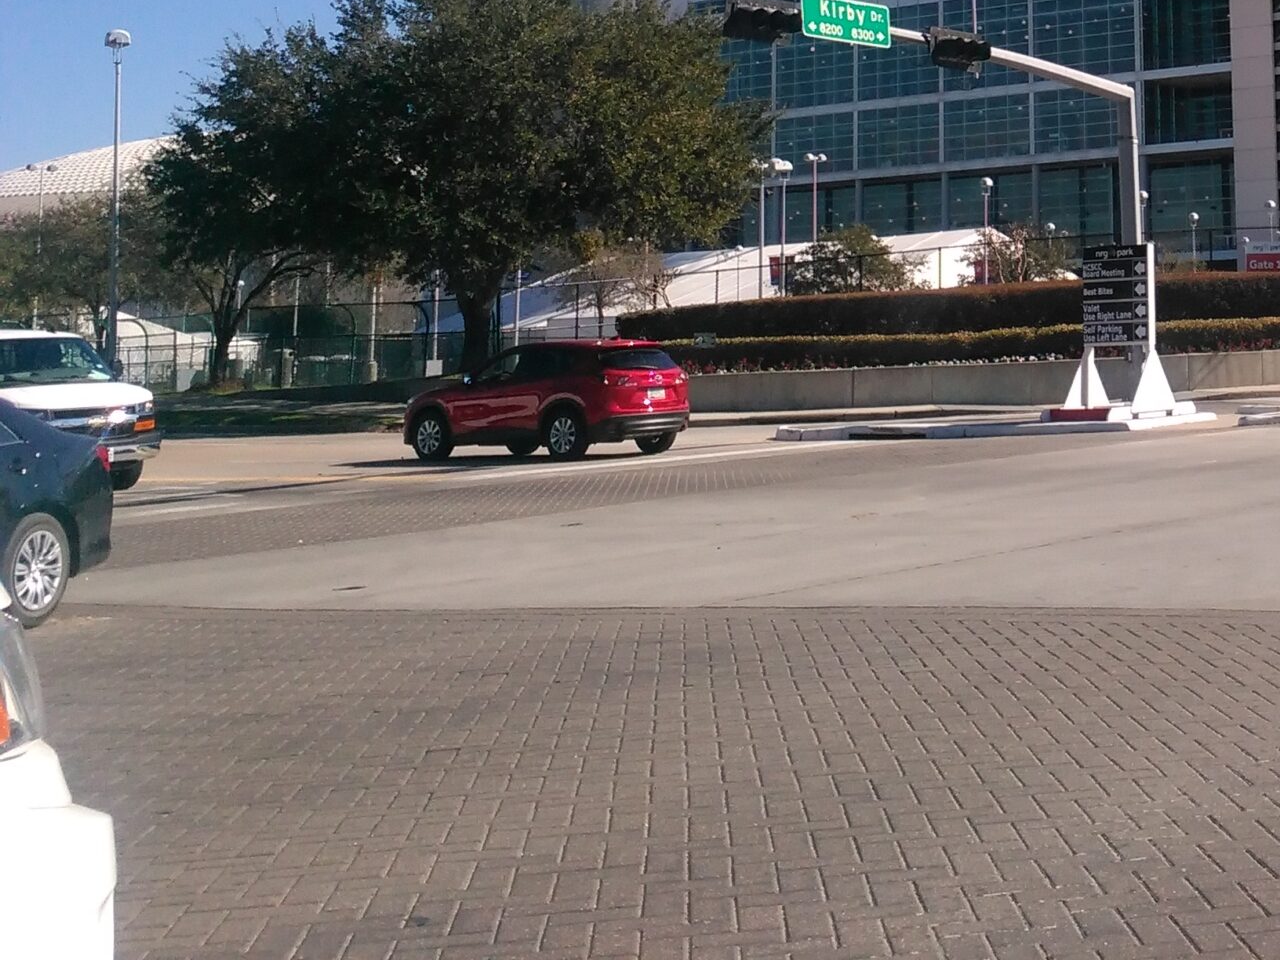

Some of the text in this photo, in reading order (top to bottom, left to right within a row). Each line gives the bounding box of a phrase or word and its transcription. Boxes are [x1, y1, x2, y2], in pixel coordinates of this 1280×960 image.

[819, 0, 885, 26] Kirby Dr.
[818, 21, 875, 42] 8200 8300
[1095, 248, 1134, 260] nrg park
[1249, 259, 1275, 269] Gate
[1101, 269, 1125, 277] Meeting
[1083, 288, 1097, 296] Best
[1083, 304, 1100, 313] Valet
[1083, 311, 1132, 321] Use Right Lane
[1084, 324, 1123, 334] Self Parking
[1084, 333, 1128, 343] Use Left Lane
